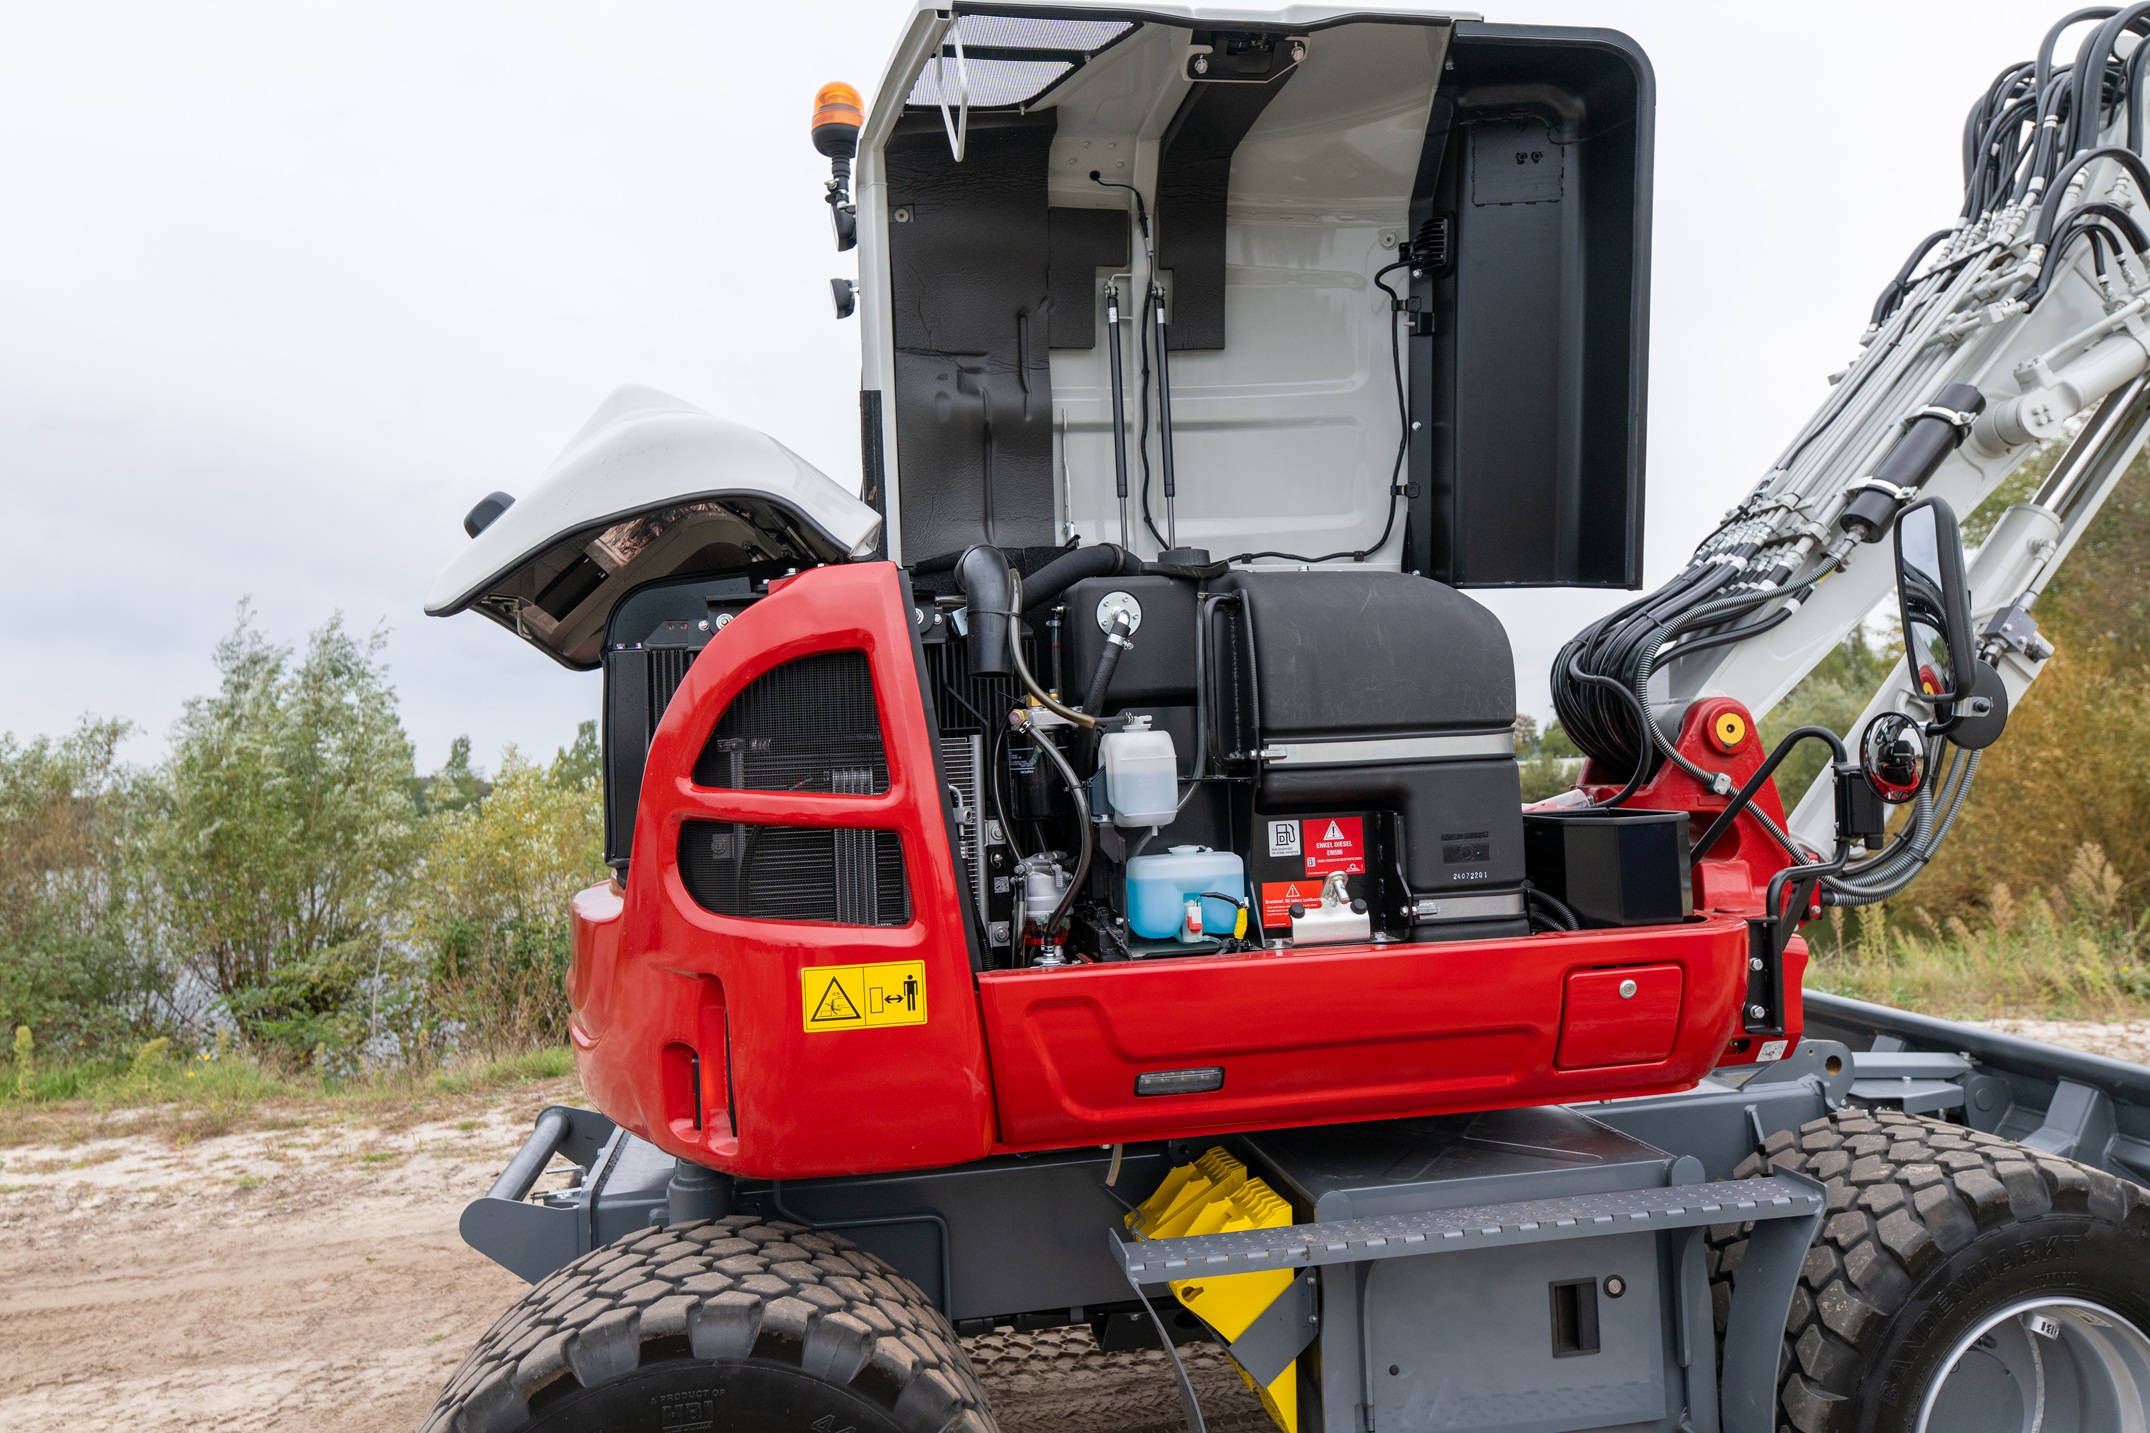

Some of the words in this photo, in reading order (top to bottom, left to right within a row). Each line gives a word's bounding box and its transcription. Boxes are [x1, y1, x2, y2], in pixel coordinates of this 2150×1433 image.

[1279, 835, 1286, 843] D
[1453, 871, 1488, 880] 24072201
[650, 1397, 658, 1405] A
[660, 1389, 710, 1403] PRODUCT
[711, 1388, 726, 1397] OF
